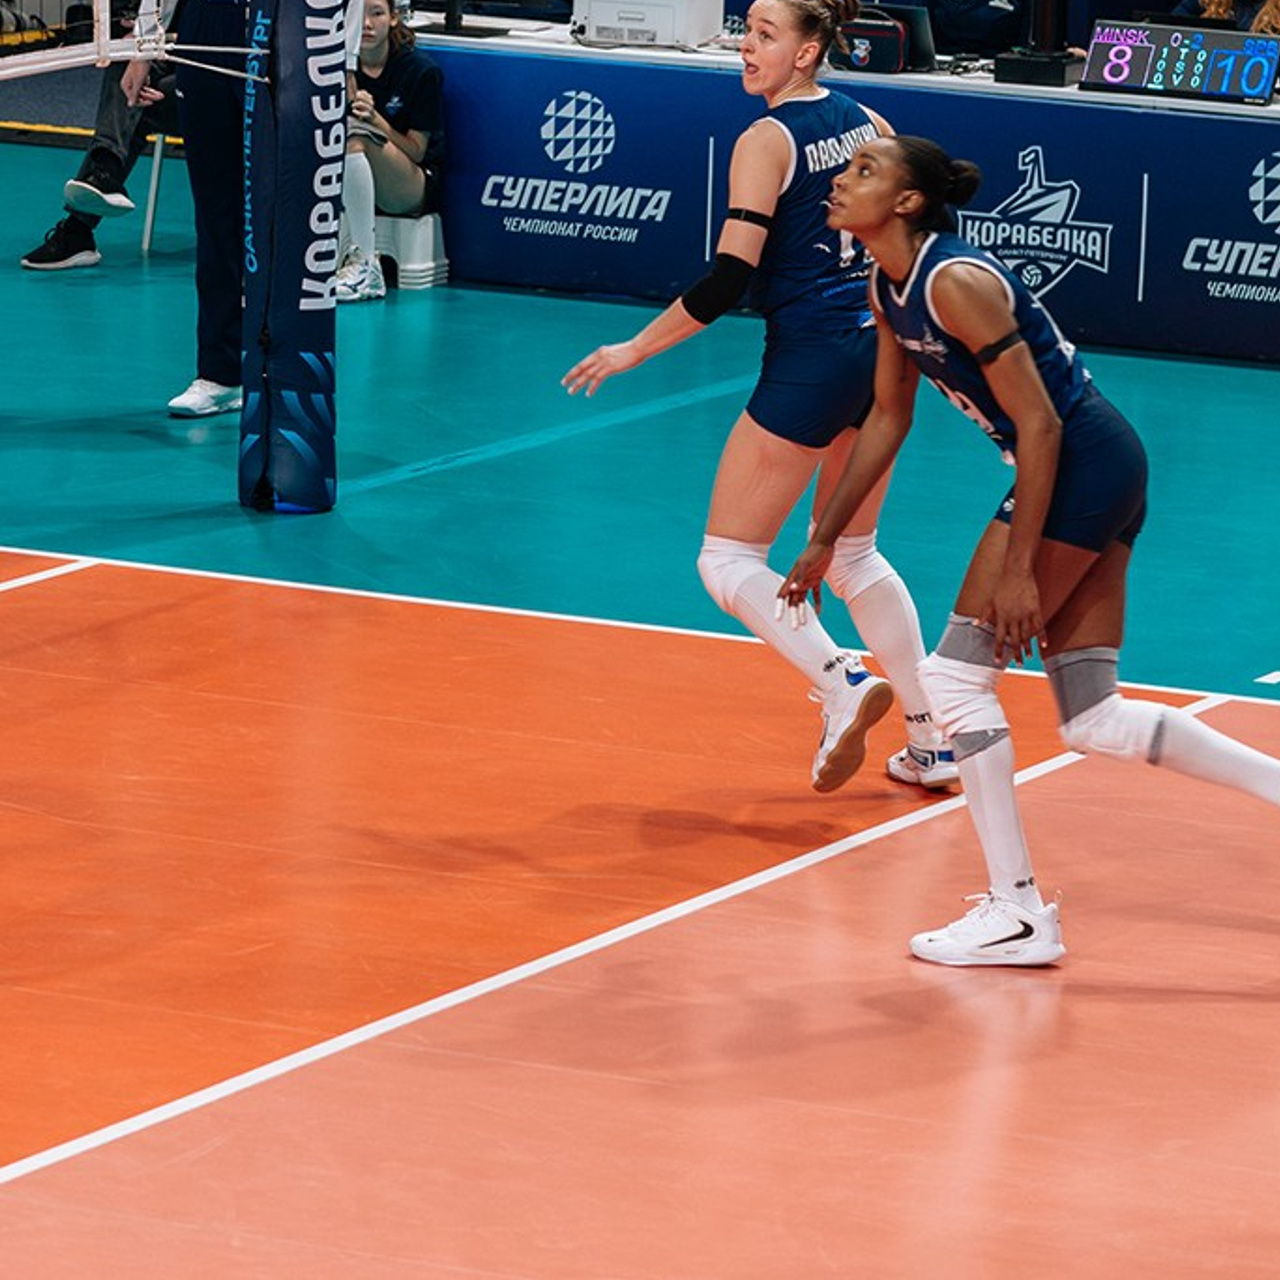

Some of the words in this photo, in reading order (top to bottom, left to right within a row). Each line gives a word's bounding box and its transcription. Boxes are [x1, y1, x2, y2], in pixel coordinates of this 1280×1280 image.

[1094, 27, 1151, 45] MINSK
[1102, 45, 1133, 83] 8
[1156, 60, 1166, 71] 0
[1174, 61, 1185, 72] S
[1193, 62, 1204, 74] 0
[1179, 48, 1189, 61] T
[1197, 50, 1207, 62] 0
[1153, 72, 1164, 84] 0
[1171, 73, 1184, 87] V
[1190, 76, 1201, 88] 0
[1216, 55, 1270, 96] 10
[480, 174, 673, 222] СУПЕРЛИГА
[502, 216, 583, 237] ЧЕМПИОНАТ
[583, 224, 639, 243] РОССИИ
[966, 219, 1102, 261] КОРАБЕЛКА
